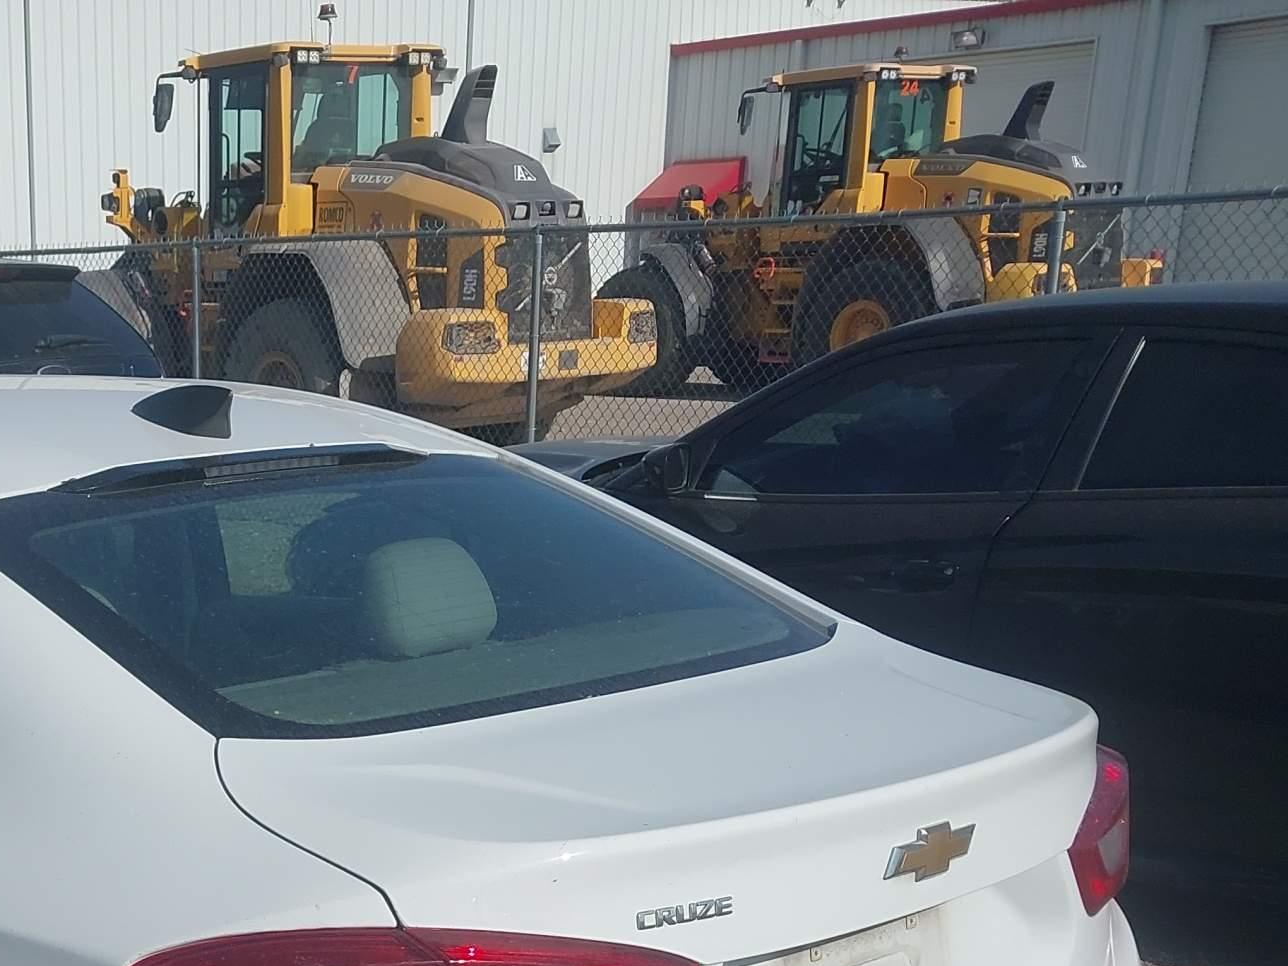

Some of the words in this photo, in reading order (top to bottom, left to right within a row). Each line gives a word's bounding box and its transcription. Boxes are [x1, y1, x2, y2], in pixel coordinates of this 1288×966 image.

[900, 80, 919, 96] 24
[350, 174, 394, 184] VOLVO
[636, 896, 733, 931] CRUZE
